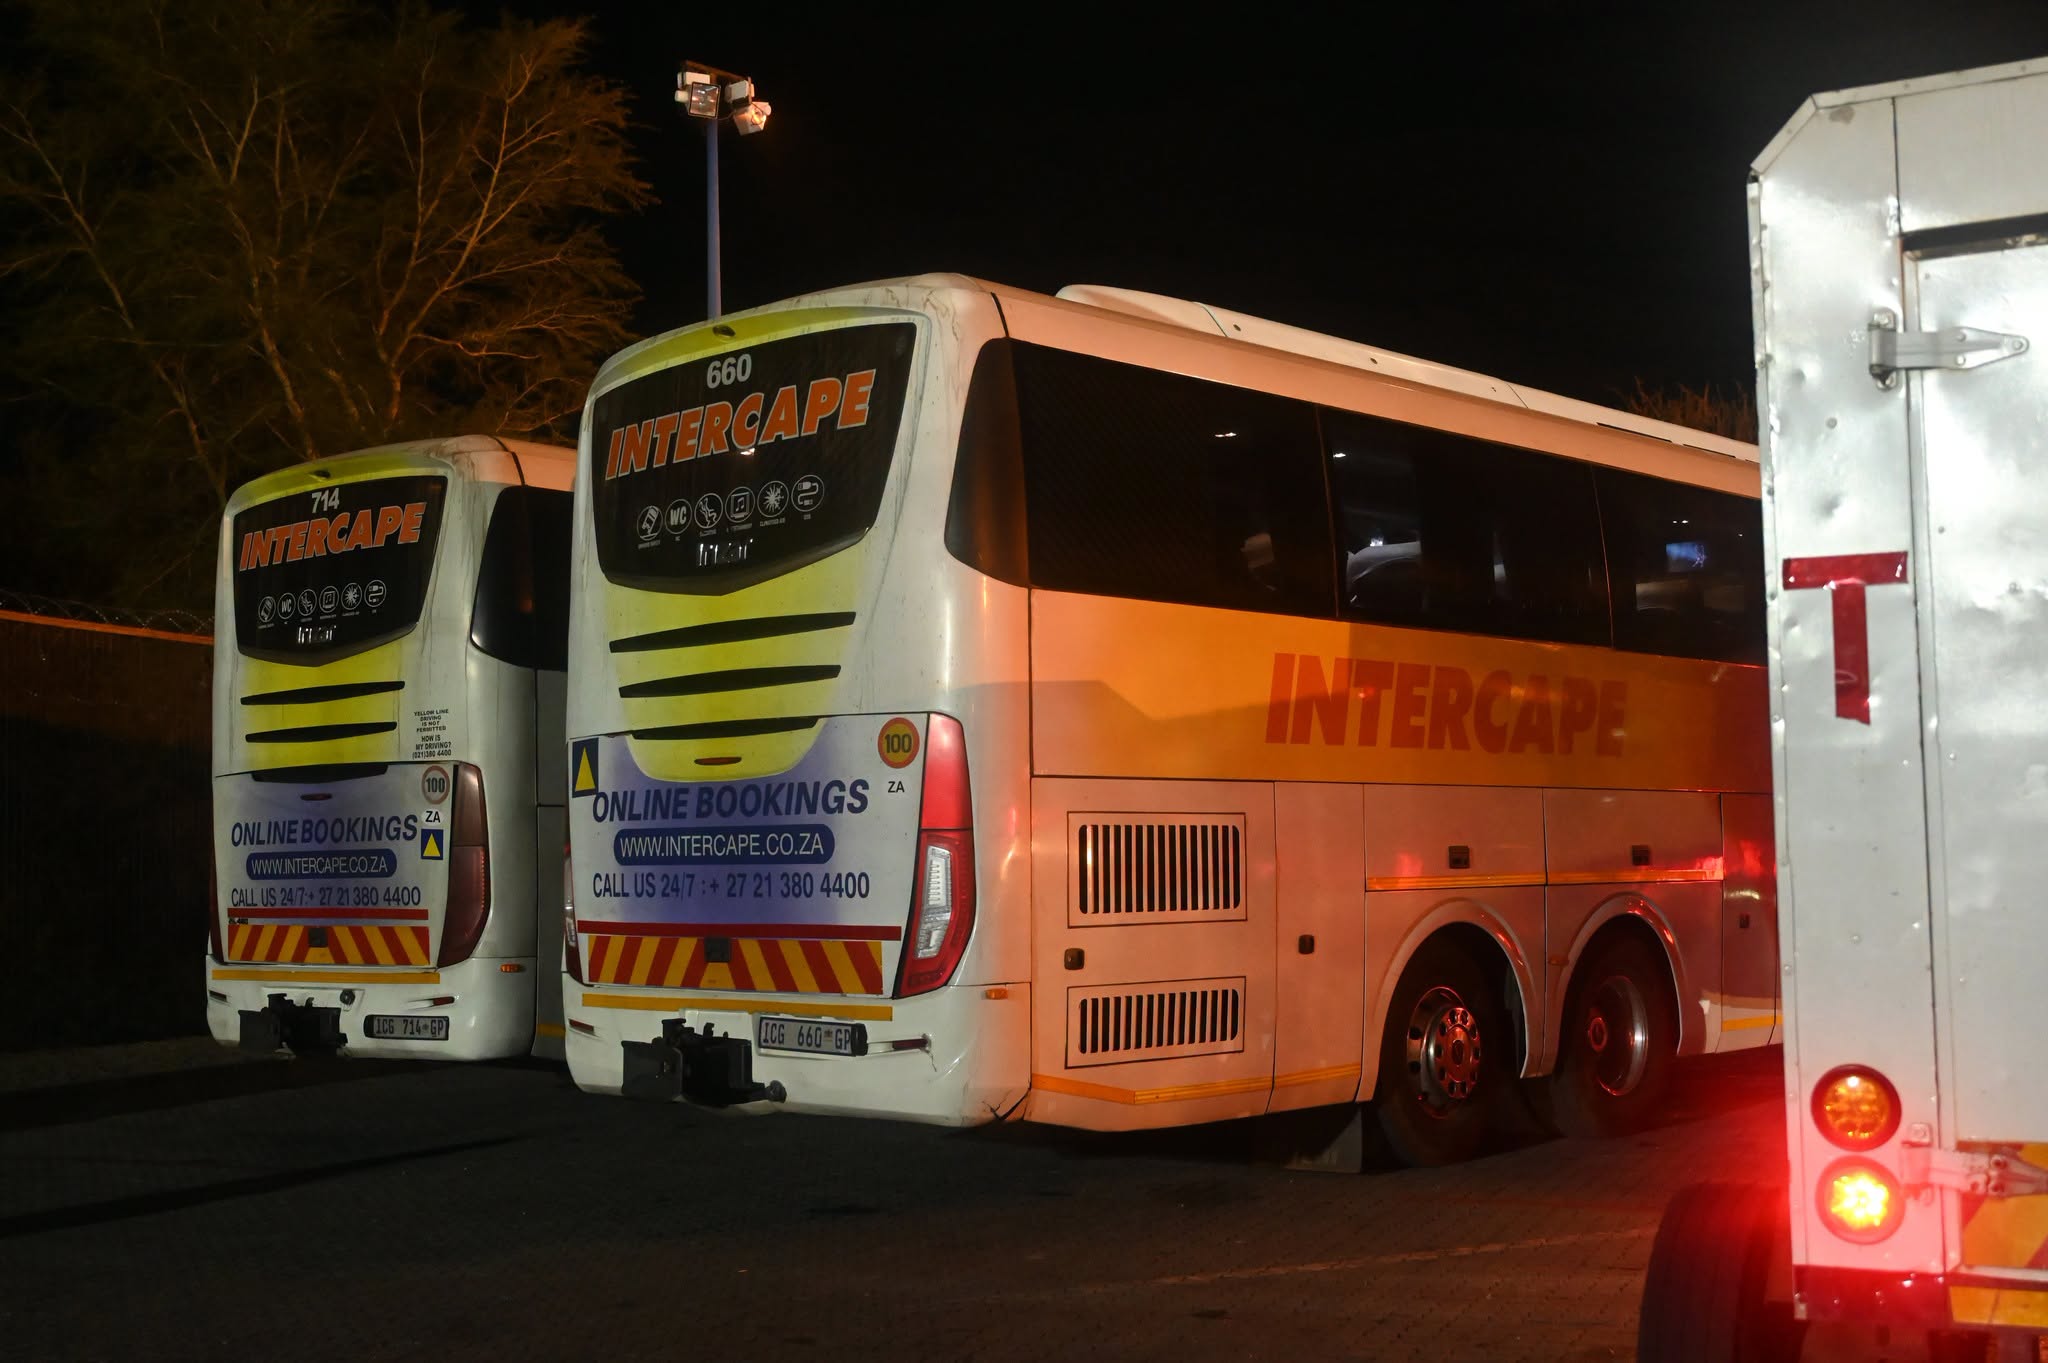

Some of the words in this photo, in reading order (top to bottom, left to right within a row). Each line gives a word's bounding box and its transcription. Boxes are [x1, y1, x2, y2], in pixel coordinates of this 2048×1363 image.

[706, 353, 752, 389] 660
[605, 369, 877, 481] INTERCAPE
[311, 487, 340, 514] 714
[670, 505, 687, 526] WC
[239, 502, 427, 572] INTERCAPE
[281, 598, 292, 614] WC
[1264, 652, 1628, 758] INTERCAPE
[416, 725, 447, 733] PERMITTED
[424, 741, 452, 750] DRIVING?
[884, 733, 913, 754] 100
[425, 777, 446, 793] 100
[887, 780, 905, 793] ZA
[592, 788, 690, 823] ONLINE
[695, 778, 870, 819] BOOKINGS
[425, 810, 441, 823] ZA
[231, 819, 299, 847] ONLINE
[300, 814, 418, 845] BOOKINGS
[619, 833, 824, 858] WWW.INTERCAPE.CO.ZA
[251, 856, 388, 876] WWW.INTERCAPE.CO.ZA
[593, 872, 630, 898] CALL
[634, 872, 656, 898] US
[726, 872, 747, 898] 27
[753, 872, 772, 898] 21
[780, 871, 814, 898] 380
[820, 871, 870, 899] 4400
[231, 887, 258, 907] CALL
[261, 887, 276, 907] US
[319, 887, 334, 906] 27
[336, 887, 350, 906] 21
[353, 886, 379, 906] 380
[383, 886, 421, 906] 4400
[402, 1018, 422, 1035] 714
[430, 1019, 444, 1037] GP
[762, 1022, 785, 1045] ICG
[797, 1025, 822, 1048] 660
[835, 1028, 851, 1050] GP
